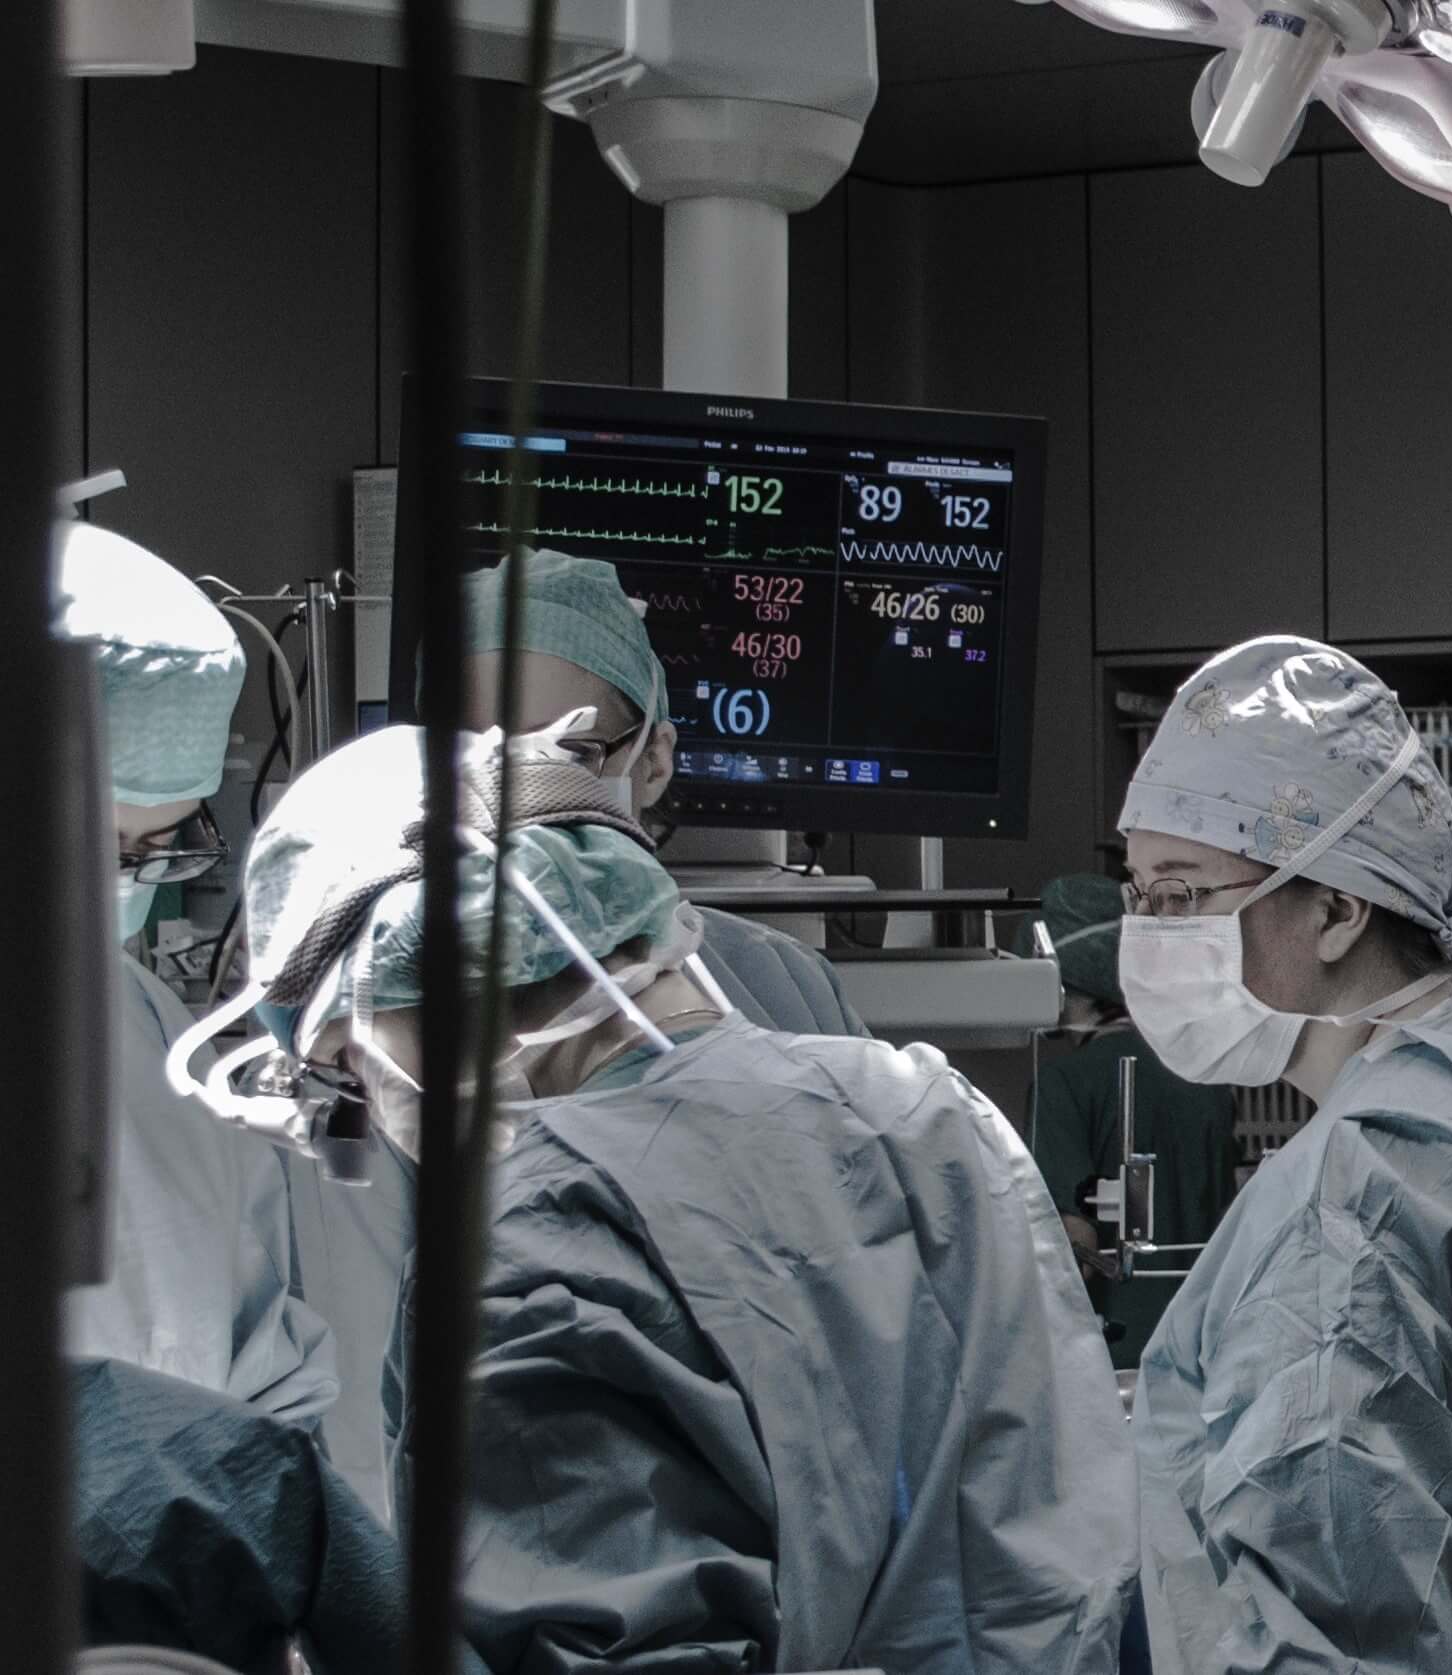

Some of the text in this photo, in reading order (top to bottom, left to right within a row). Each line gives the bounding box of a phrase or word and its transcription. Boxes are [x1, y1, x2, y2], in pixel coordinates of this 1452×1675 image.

[707, 406, 754, 419] PHILIPS
[724, 475, 784, 516] 152
[859, 484, 902, 522] 89
[940, 495, 990, 529] 152
[733, 574, 805, 604] 53/22
[756, 603, 790, 622] (35)
[870, 591, 985, 624] 46/26 (30)
[730, 631, 801, 660] 46/30
[911, 646, 932, 658] 35.1
[964, 650, 987, 662] 37.2
[752, 659, 787, 679] (37)
[713, 688, 770, 735] (6)
